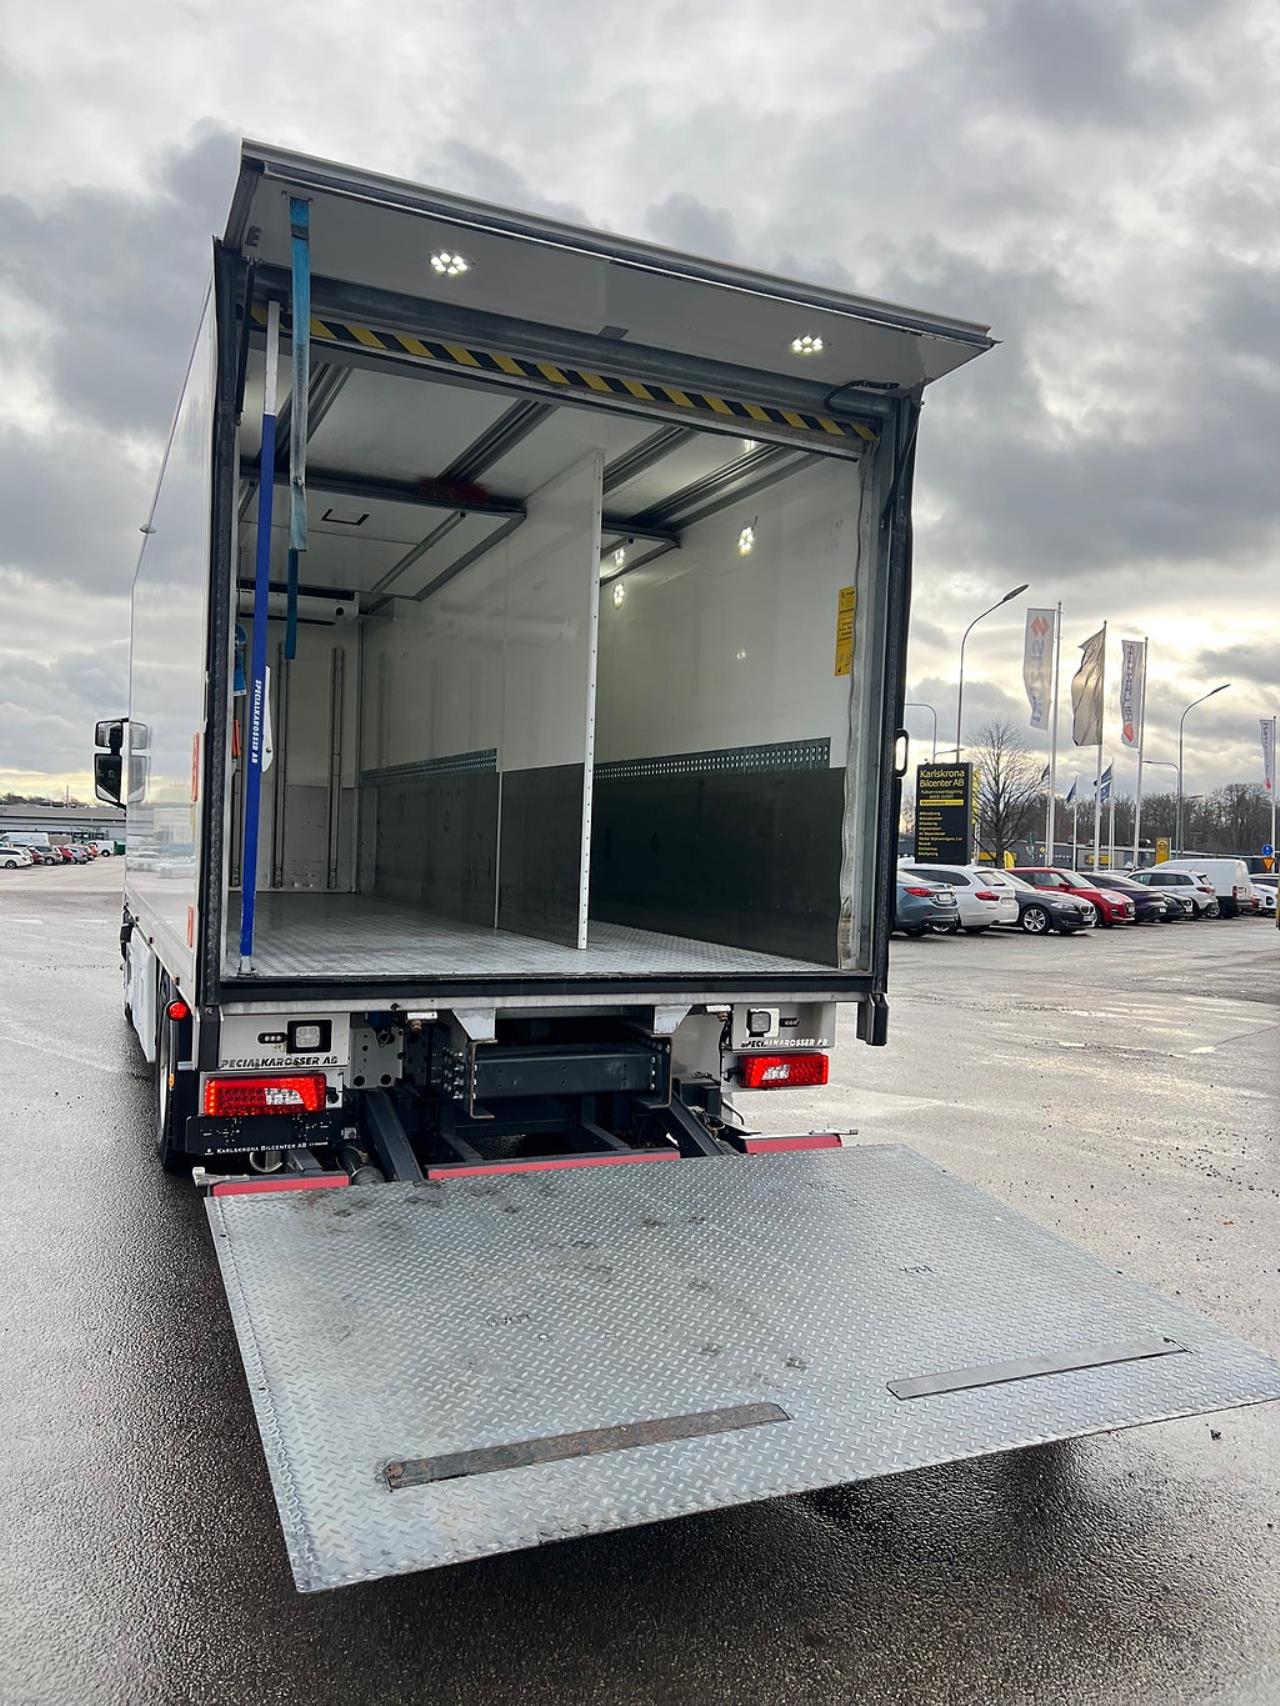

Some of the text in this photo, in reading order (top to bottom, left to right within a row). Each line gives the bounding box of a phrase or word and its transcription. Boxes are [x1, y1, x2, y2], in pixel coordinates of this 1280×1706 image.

[252, 680, 261, 763] SPECIALKAROSSER AB
[920, 769, 965, 778] Karlskrona
[920, 778, 965, 788] Bilcenter AB
[220, 1056, 319, 1068] PECIALKAROSSER
